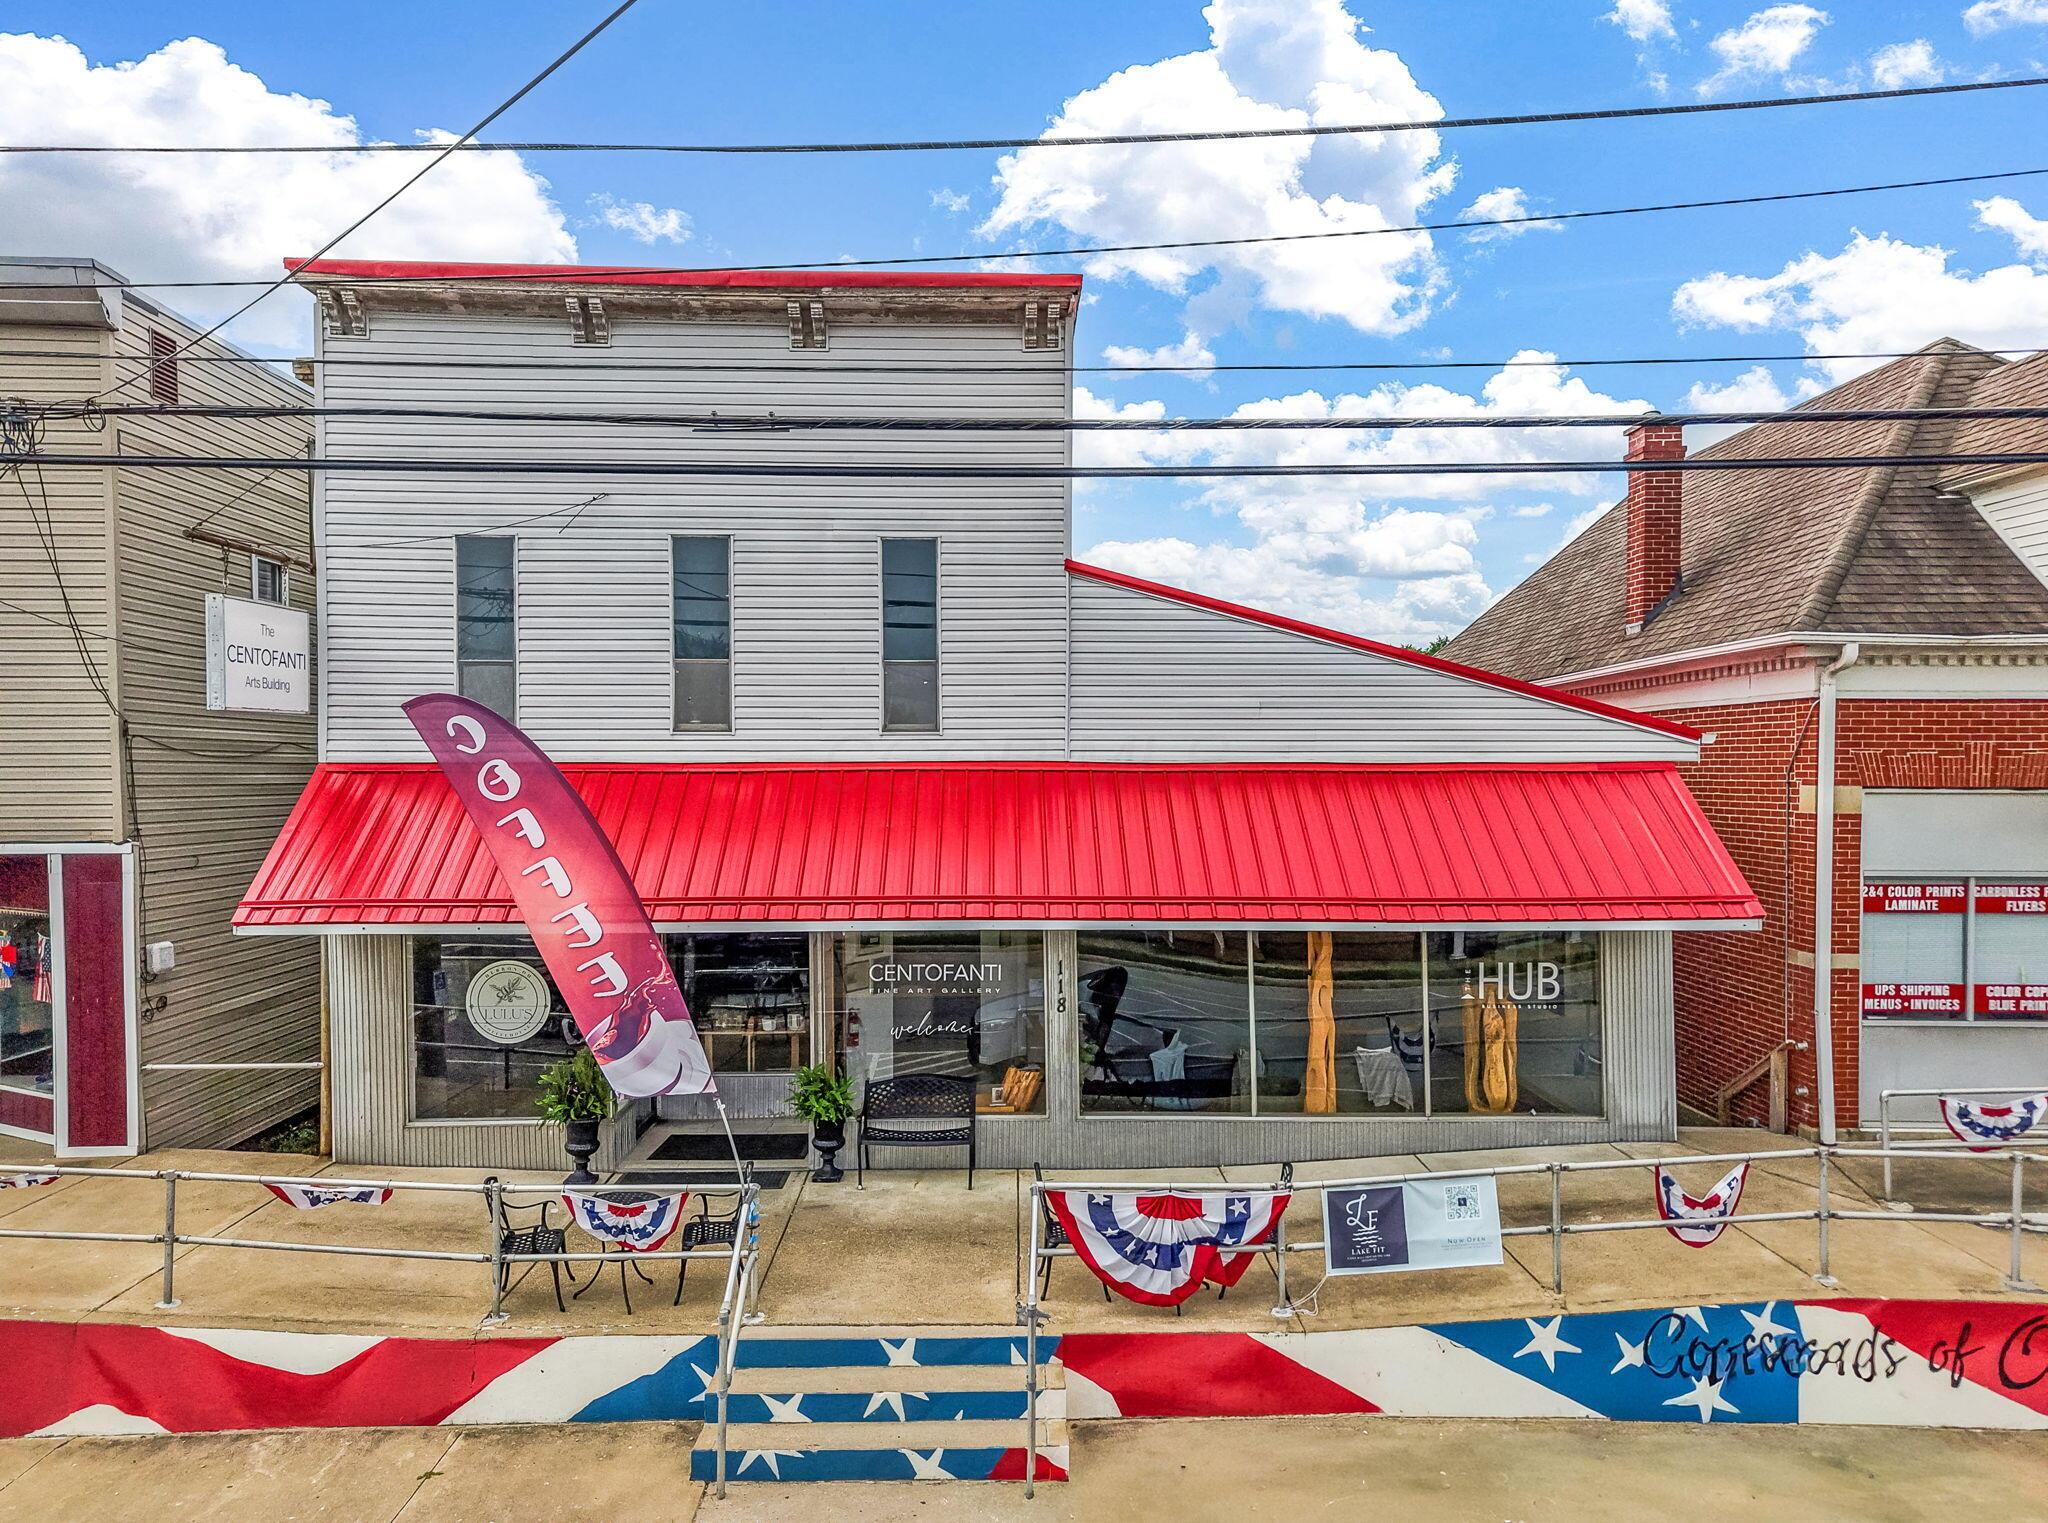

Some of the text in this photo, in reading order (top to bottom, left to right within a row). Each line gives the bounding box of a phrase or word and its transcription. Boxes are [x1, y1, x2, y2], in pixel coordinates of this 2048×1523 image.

[260, 623, 275, 638] The
[227, 644, 306, 670] CENTOFANTI
[245, 676, 291, 693] Arts Building
[1887, 886, 1922, 898] COLOR
[1925, 886, 1965, 898] PRINTS
[1974, 886, 2040, 898] CARBONLESS
[1884, 899, 1939, 911] LAMINATE
[2006, 900, 2047, 912] FLYERS
[869, 963, 1002, 982] CENTOFANTI
[1478, 962, 1560, 1000] HUB
[1874, 984, 1950, 996] UPS SHIPPING
[1986, 986, 2022, 997] COLOR
[1864, 998, 1960, 1010] MENUS INVOICES
[1988, 999, 2016, 1011] BLUE
[485, 1008, 533, 1020] LULU'S
[890, 1010, 974, 1040] welcome
[1351, 1246, 1386, 1256] LAKE FIT
[1928, 1321, 1986, 1388] of
